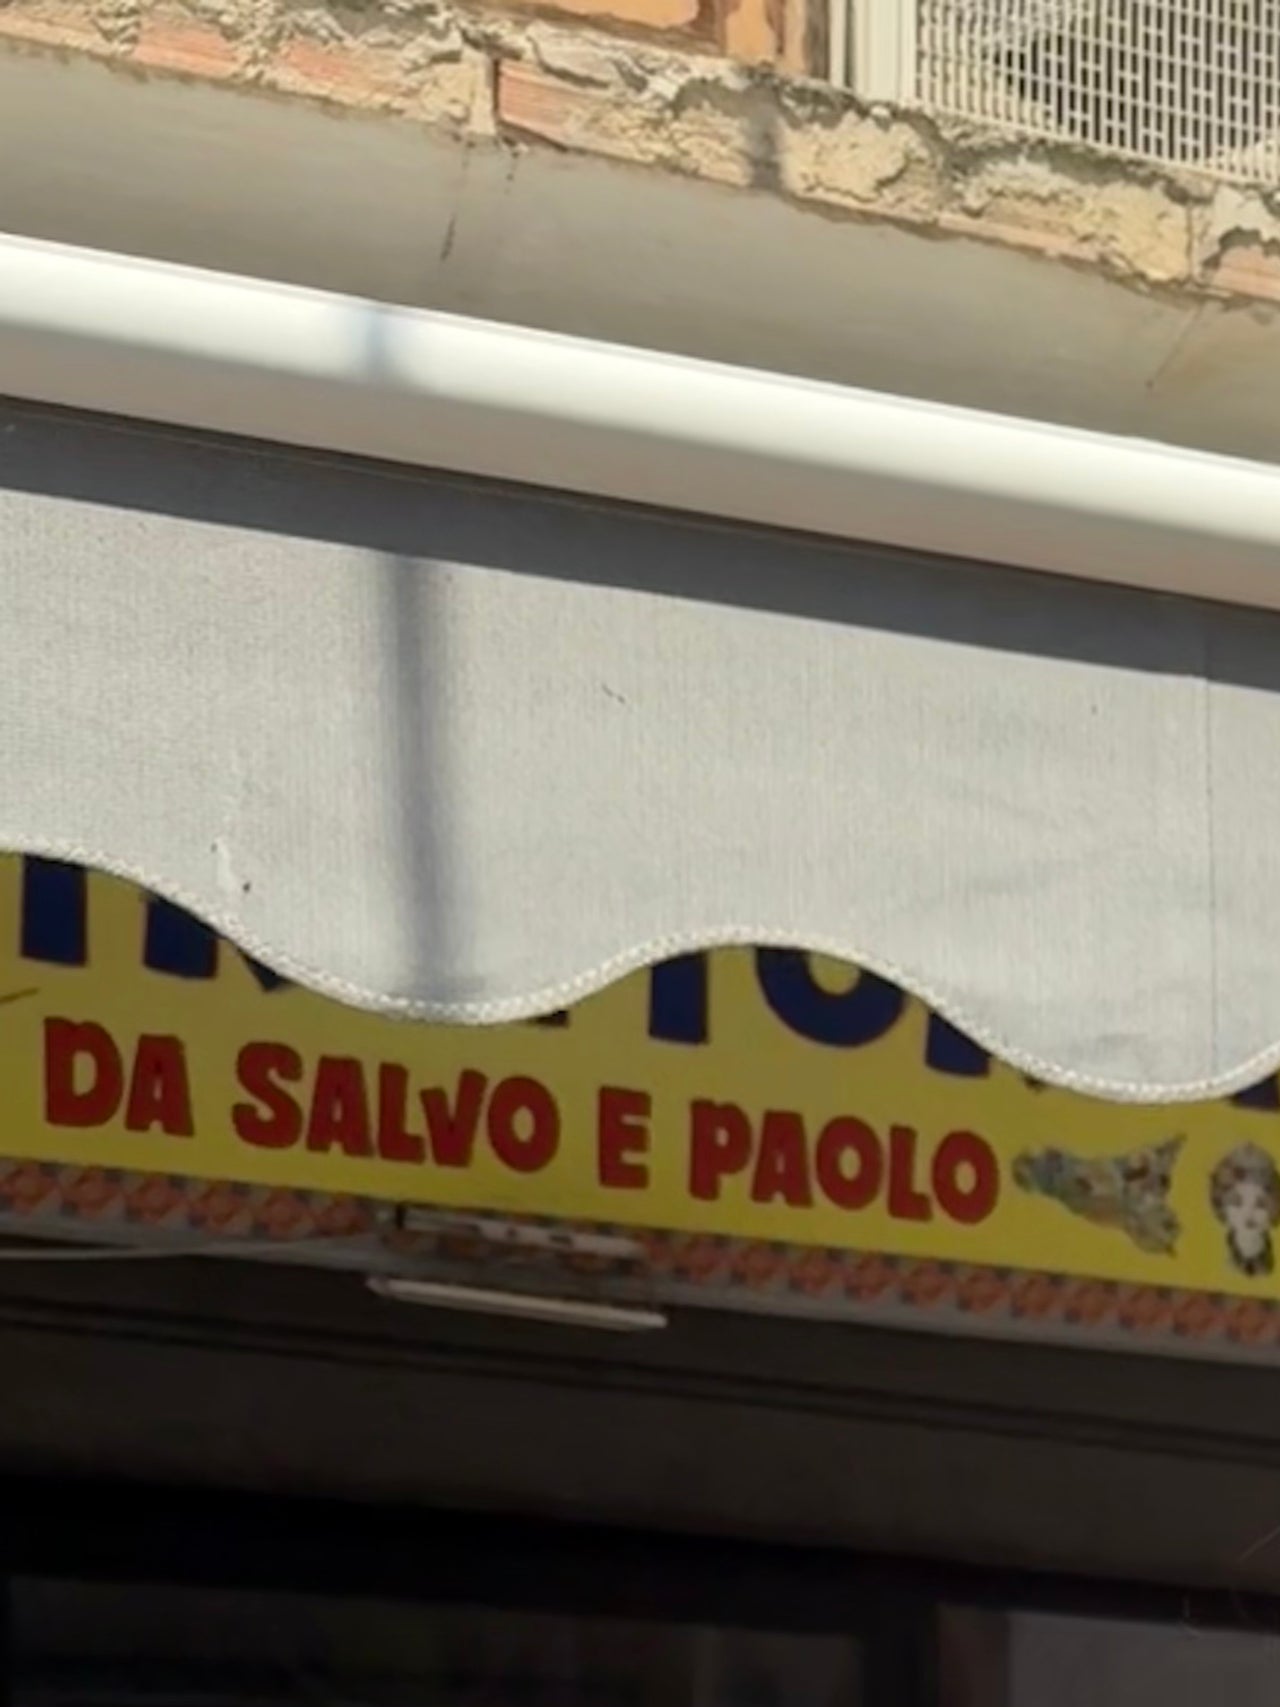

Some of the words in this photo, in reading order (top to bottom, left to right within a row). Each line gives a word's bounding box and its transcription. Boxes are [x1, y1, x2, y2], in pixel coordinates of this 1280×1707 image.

[42, 1016, 194, 1139] DA
[231, 1043, 561, 1176] SALVO
[598, 1088, 650, 1189] E
[688, 1099, 999, 1224] PAOLO
